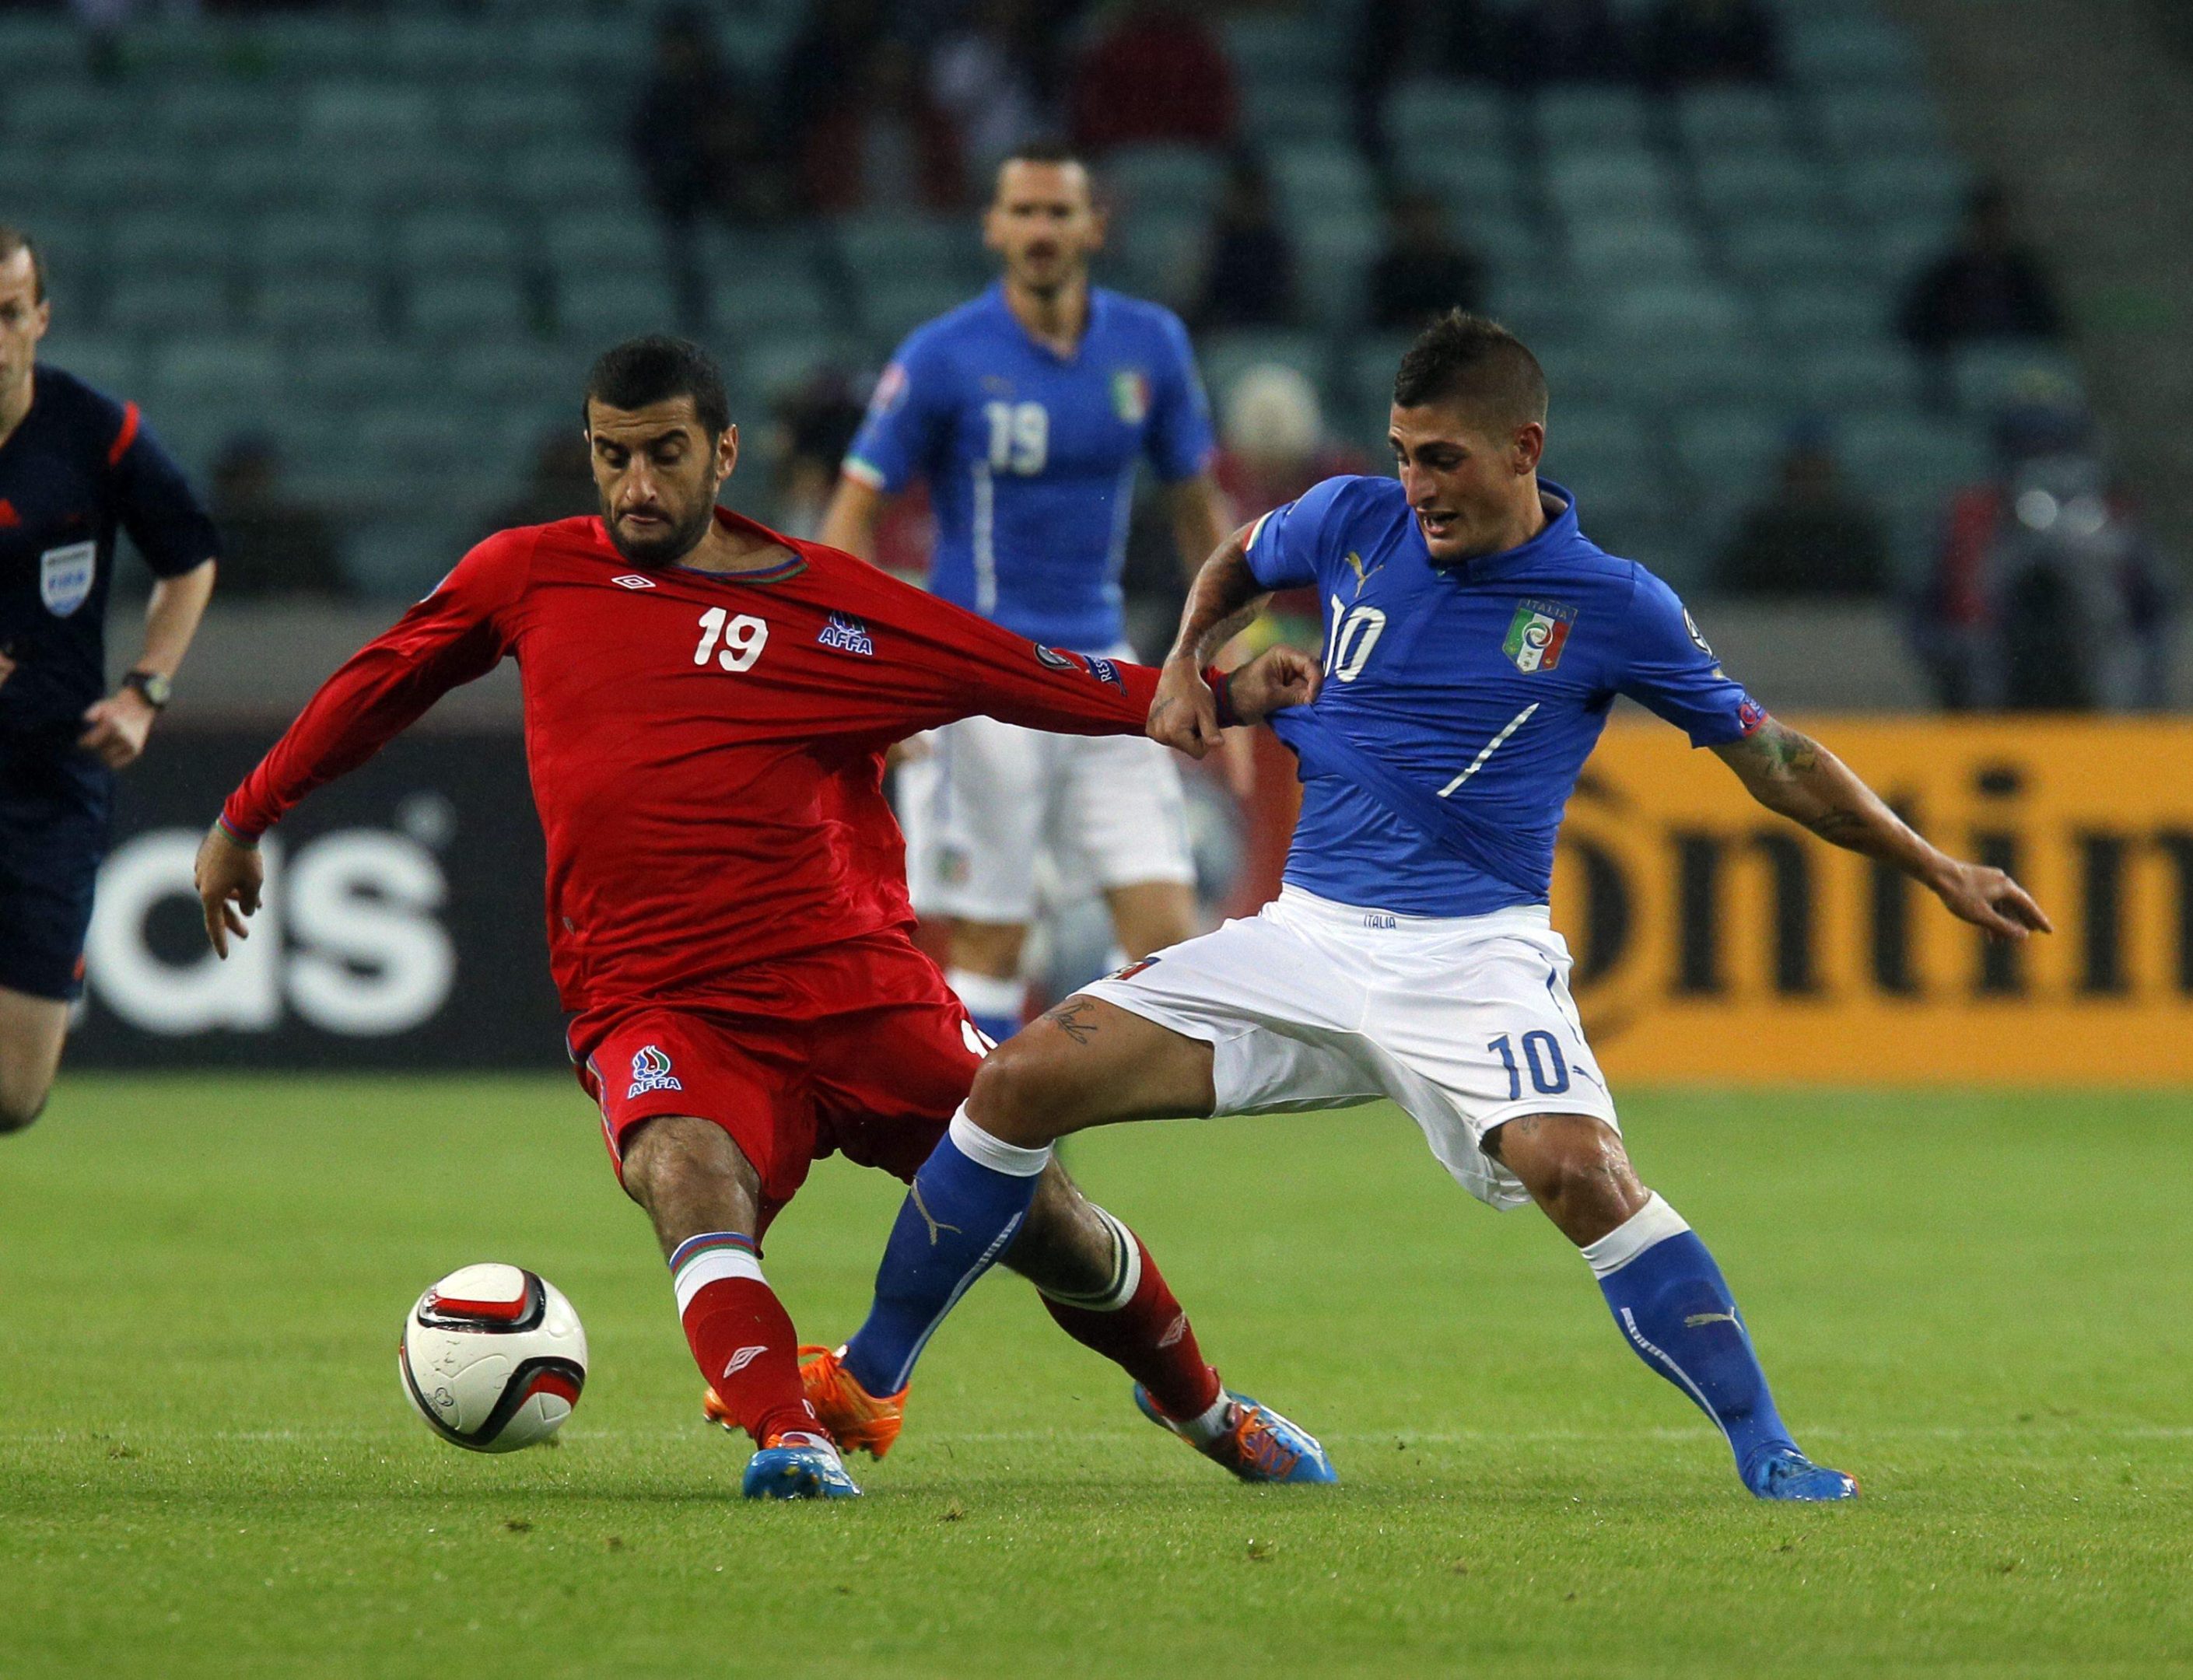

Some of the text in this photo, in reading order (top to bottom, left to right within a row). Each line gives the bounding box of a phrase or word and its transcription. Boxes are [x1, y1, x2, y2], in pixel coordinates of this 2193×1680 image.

[985, 401, 1048, 475] 19
[1526, 599, 1568, 620] ITALIA
[694, 607, 769, 672] 19
[818, 627, 873, 656] AFFA
[1323, 593, 1386, 682] 10
[1363, 914, 1396, 929] ITALIA
[628, 1077, 681, 1099] AFFA
[1487, 1030, 1570, 1101] 10
